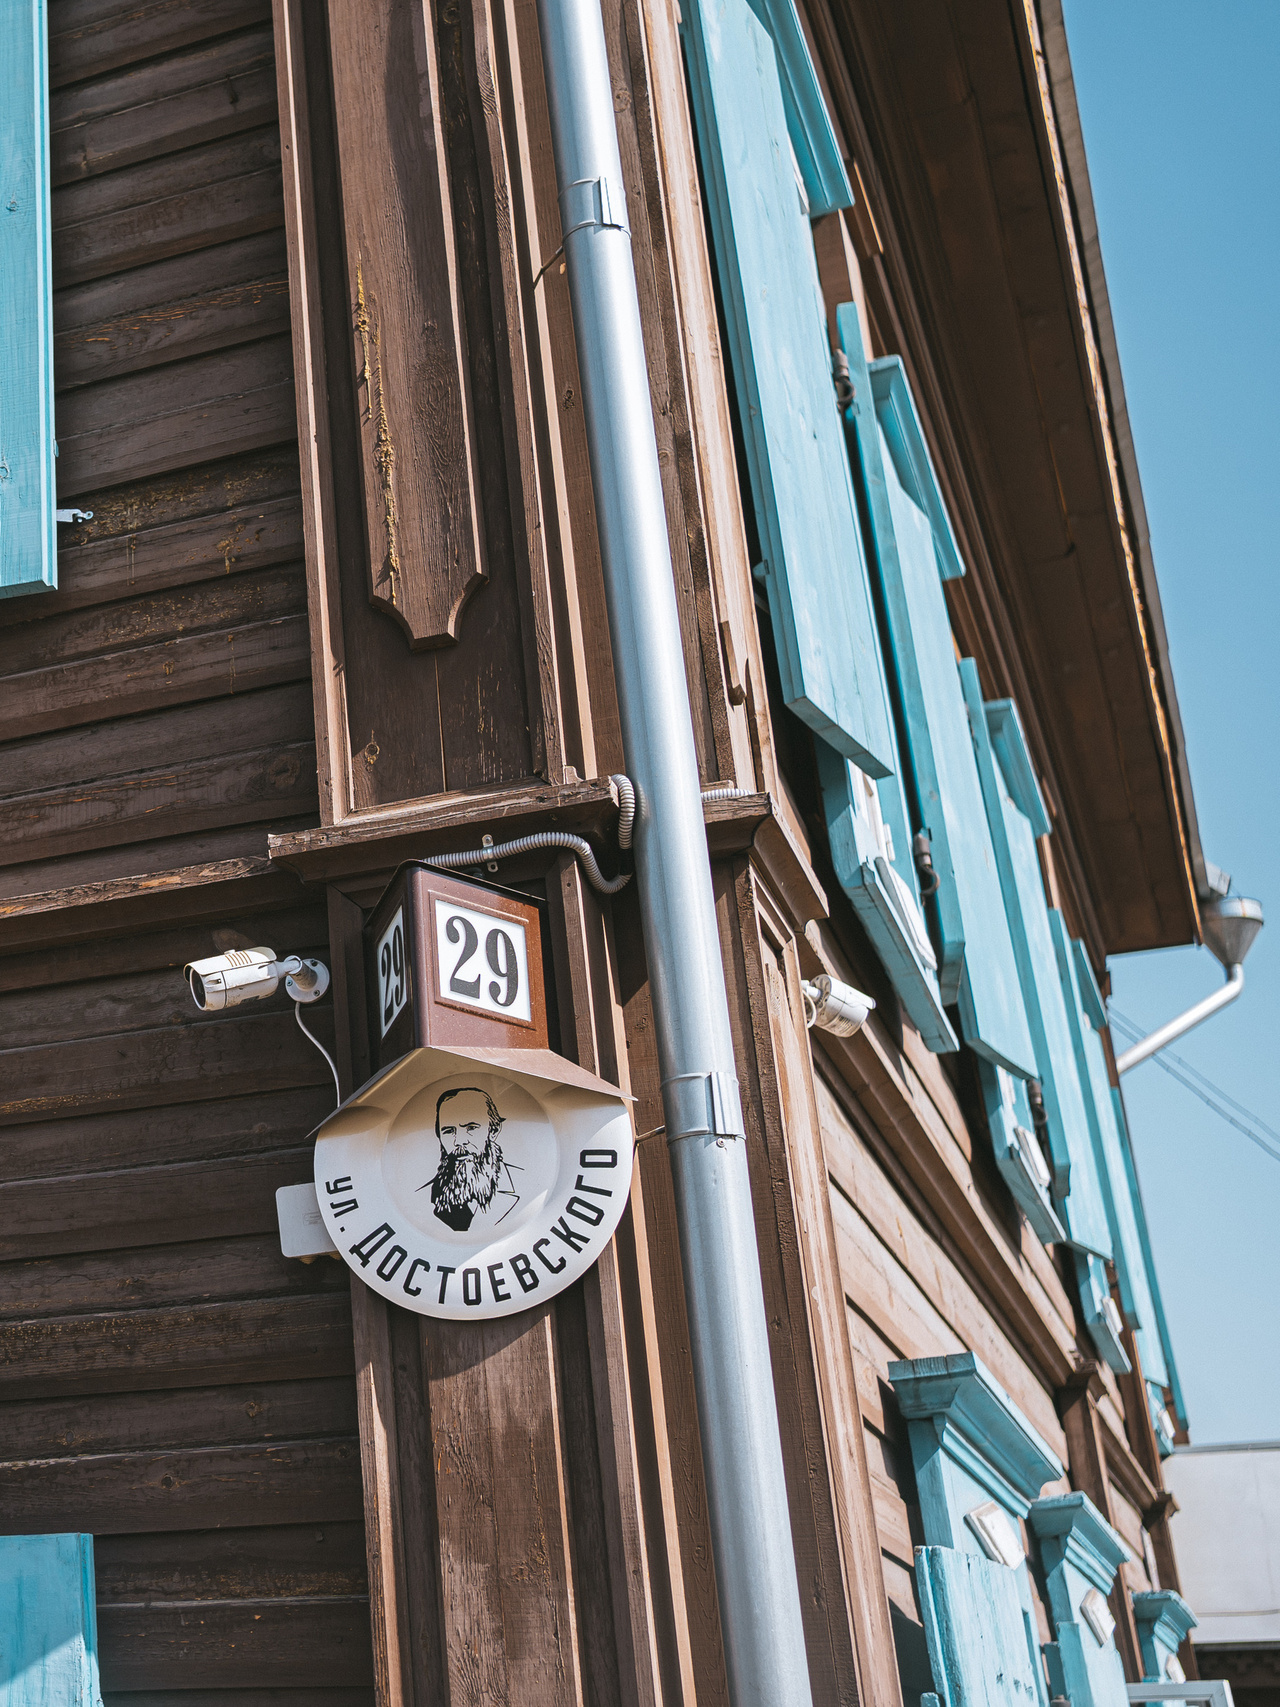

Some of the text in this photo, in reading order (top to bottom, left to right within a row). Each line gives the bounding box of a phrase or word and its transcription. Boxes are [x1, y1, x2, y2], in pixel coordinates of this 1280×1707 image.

[381, 925, 405, 1027] 29
[445, 915, 519, 1007] 29
[348, 1149, 618, 1306] ДОСТОЕВСКОГО
